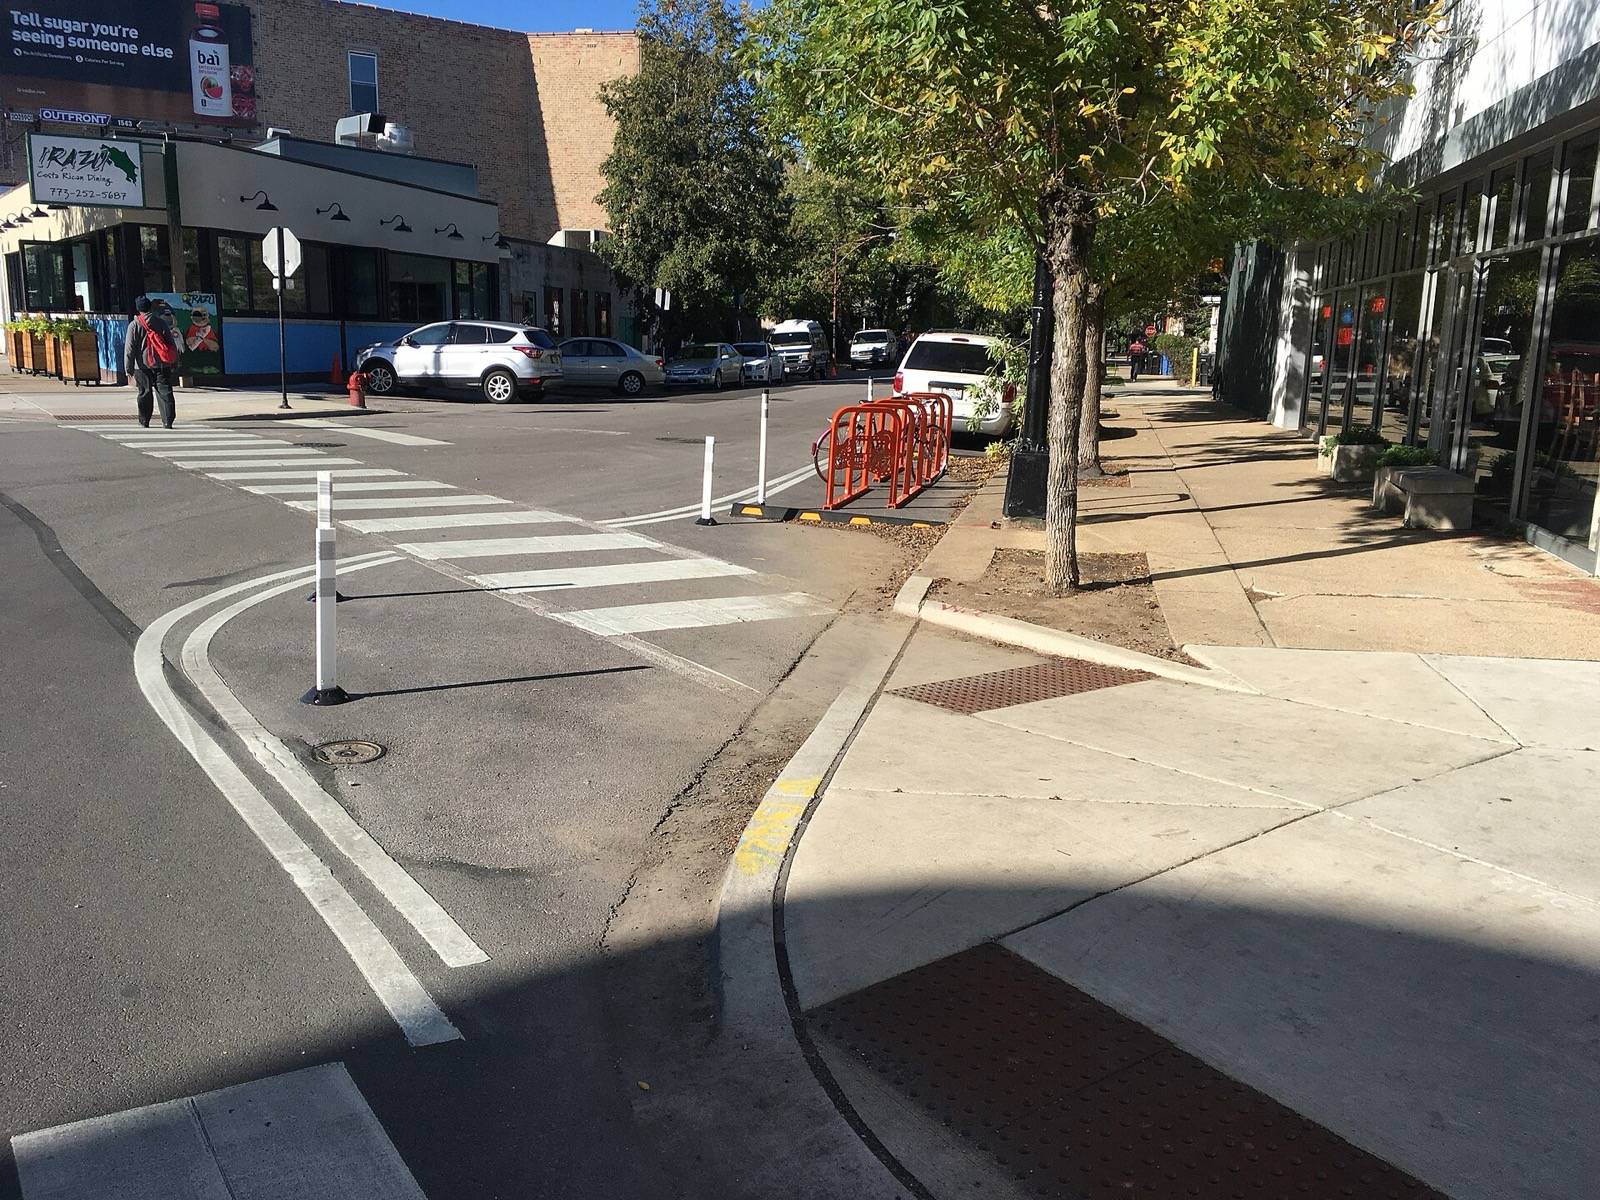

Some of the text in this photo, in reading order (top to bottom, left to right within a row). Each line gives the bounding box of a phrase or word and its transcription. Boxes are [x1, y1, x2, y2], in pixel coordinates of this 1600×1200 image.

[10, 10, 139, 39] Tell sugar you're
[12, 29, 174, 59] seeing someone else
[197, 49, 220, 66] bai
[42, 110, 107, 124] OUTFRONT
[36, 170, 114, 187] Costa Rican Dining
[49, 187, 127, 201] 773-252-5687
